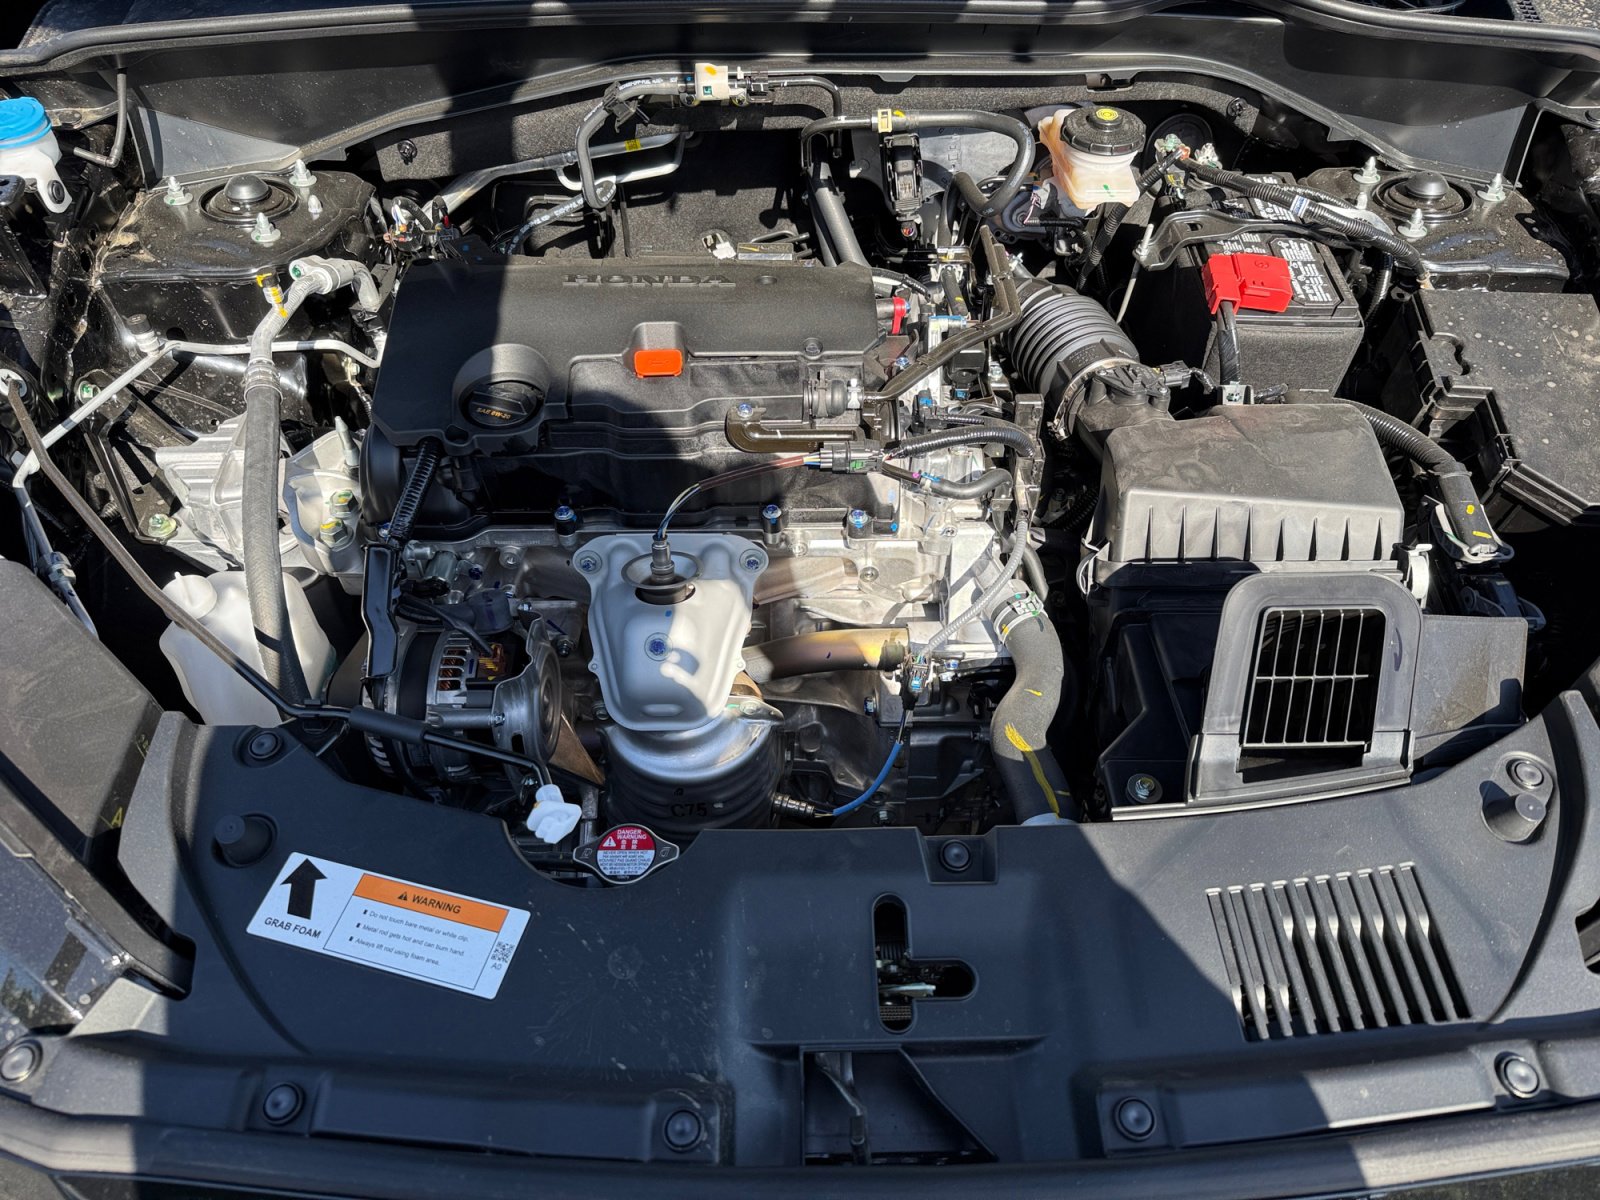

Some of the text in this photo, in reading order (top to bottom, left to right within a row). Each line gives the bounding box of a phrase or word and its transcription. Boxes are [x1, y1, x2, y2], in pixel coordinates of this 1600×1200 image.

[563, 275, 736, 287] HONDA
[671, 803, 707, 817] C75
[412, 894, 462, 914] WARNING
[264, 917, 322, 939] GRAB FOAM
[369, 910, 378, 918] Do
[389, 916, 404, 925] touch
[405, 920, 417, 928] bare
[419, 925, 434, 933] metal
[442, 931, 457, 939] white
[363, 924, 377, 933] Metal
[388, 932, 401, 940] gets
[412, 938, 424, 946] and
[435, 944, 448, 952] burn
[355, 938, 375, 948] Always
[394, 950, 410, 958] using
[410, 952, 425, 961] foam
